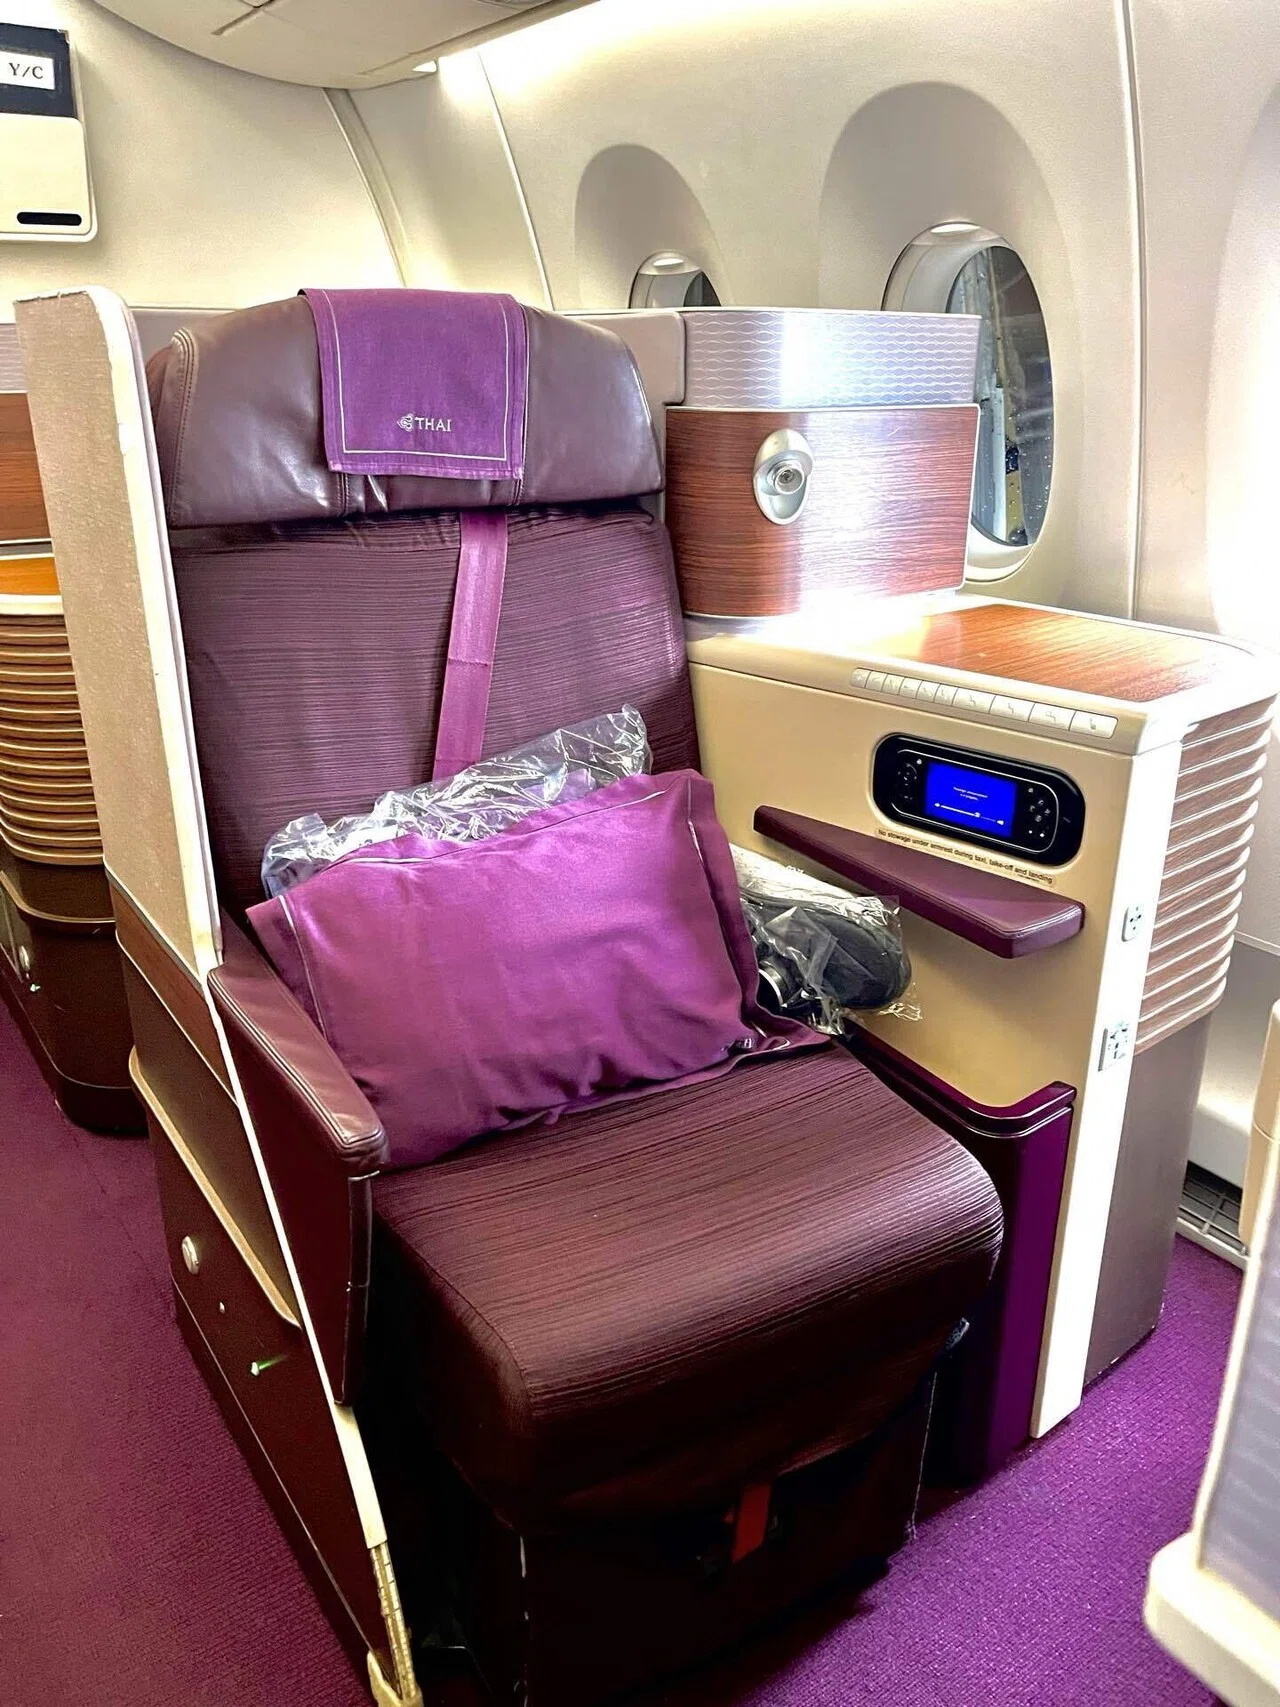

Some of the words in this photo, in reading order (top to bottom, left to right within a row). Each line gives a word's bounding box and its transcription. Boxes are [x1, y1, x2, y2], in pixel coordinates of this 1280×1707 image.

[8, 62, 44, 80] Y/C
[414, 416, 452, 432] THAI
[878, 829, 887, 837] No
[887, 832, 911, 843] stowage
[912, 839, 929, 847] under
[930, 843, 954, 854] armrest
[954, 849, 973, 861] during
[989, 859, 1013, 871] take-off
[1014, 867, 1028, 876] and
[1028, 870, 1053, 884] landing
